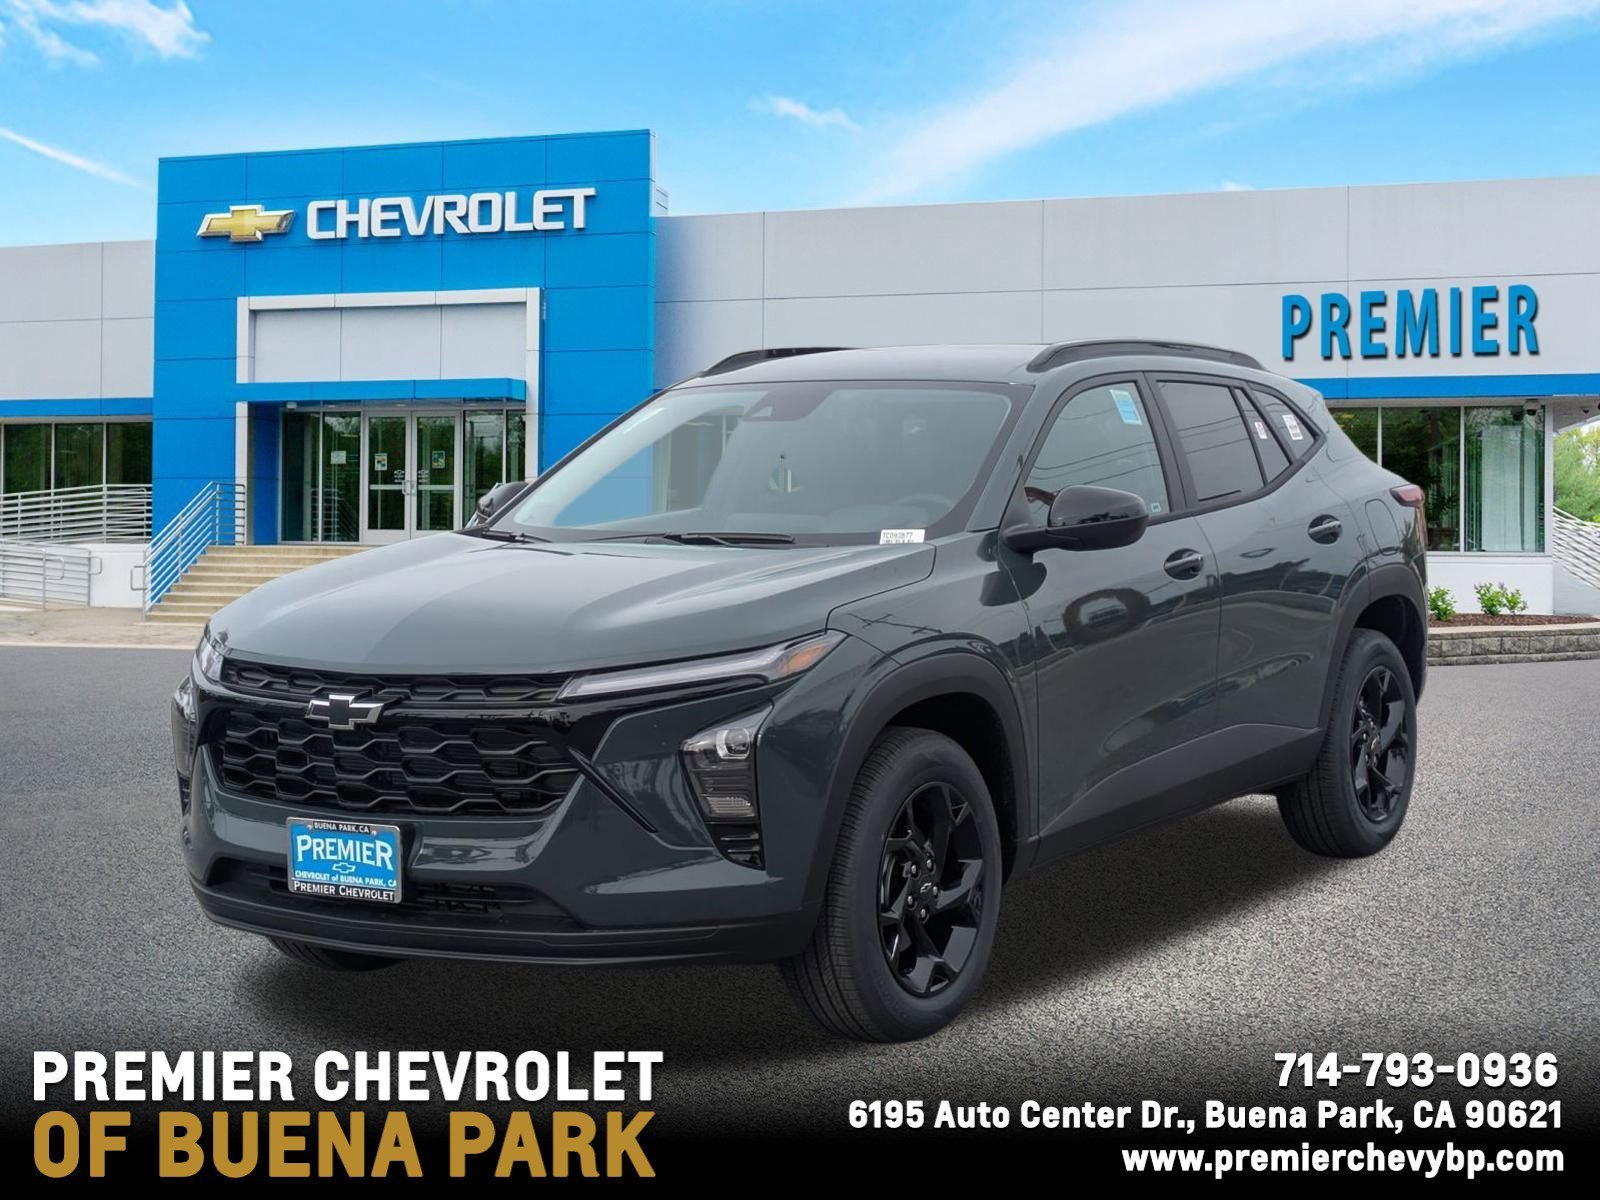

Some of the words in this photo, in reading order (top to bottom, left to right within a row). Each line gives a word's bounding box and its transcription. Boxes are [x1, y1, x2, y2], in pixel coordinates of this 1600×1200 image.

[307, 187, 596, 240] CHEVROLET
[1282, 284, 1540, 360] PREMIER
[314, 822, 337, 831] BUENA
[296, 834, 394, 871] PREMIER
[294, 881, 336, 895] PREMIER
[338, 885, 395, 901] CHEVROLET
[295, 870, 330, 881] CHEVROLET
[331, 874, 339, 882] of
[340, 875, 363, 884] BUENA
